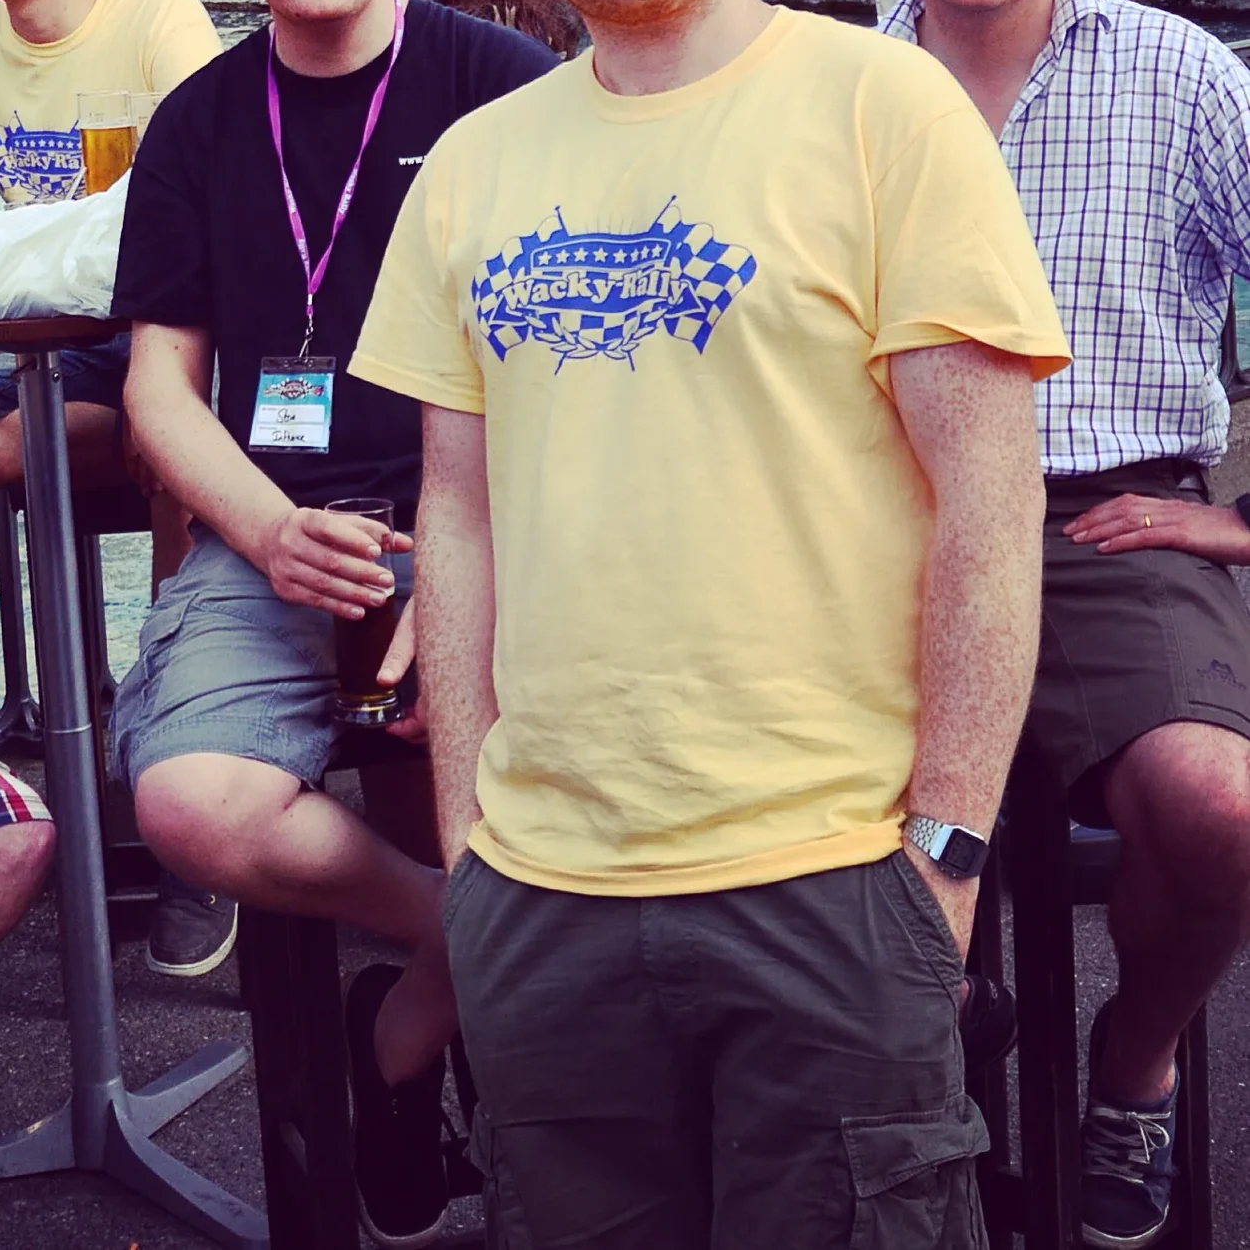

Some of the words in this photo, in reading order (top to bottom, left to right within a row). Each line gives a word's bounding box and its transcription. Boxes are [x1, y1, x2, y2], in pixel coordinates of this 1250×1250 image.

[3, 153, 51, 170] Wacky
[53, 152, 80, 170] Ra
[502, 271, 616, 310] Wacky
[619, 270, 688, 306] Rally
